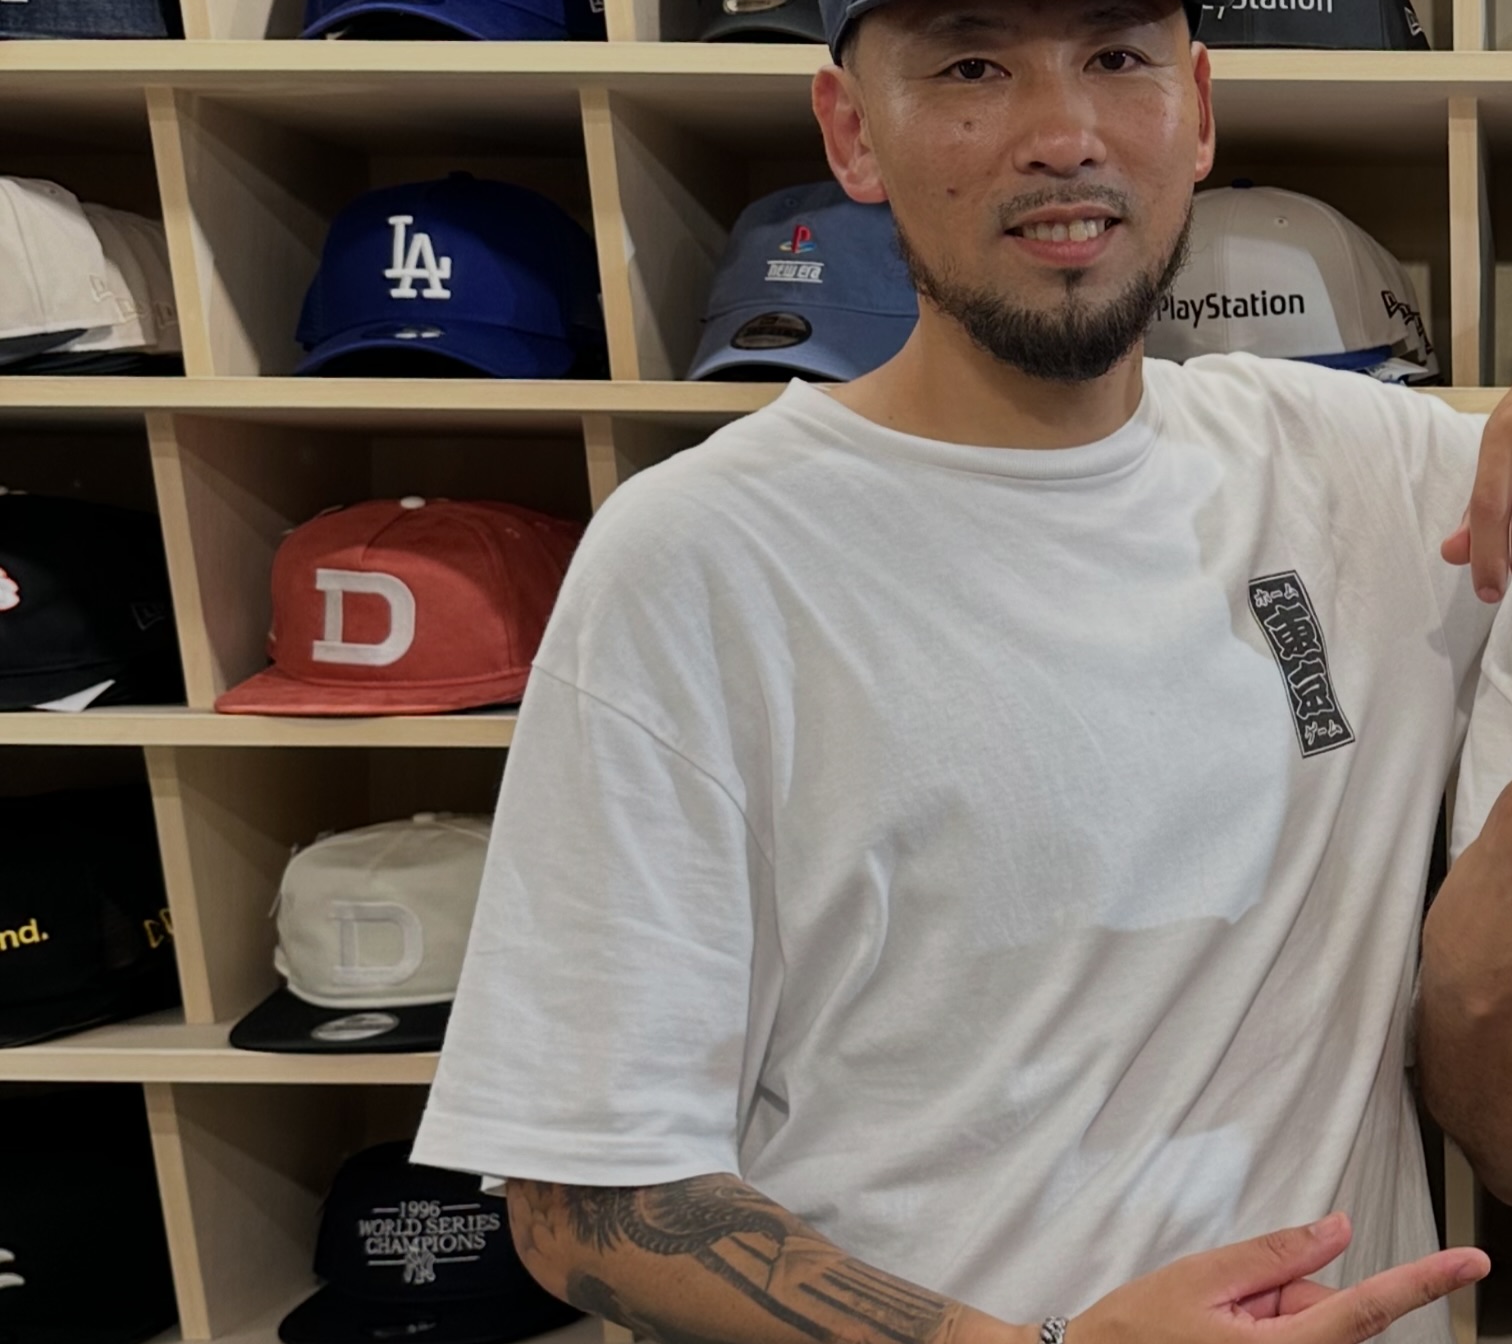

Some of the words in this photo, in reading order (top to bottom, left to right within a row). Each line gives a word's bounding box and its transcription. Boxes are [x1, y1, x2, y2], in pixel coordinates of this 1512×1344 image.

[382, 213, 452, 300] LA
[311, 566, 417, 668] D
[328, 897, 424, 986] D
[358, 1216, 423, 1237] WORLD
[425, 1212, 501, 1234] SERIES
[398, 1199, 441, 1220] 1996
[364, 1231, 486, 1256] CHAMPIONS
